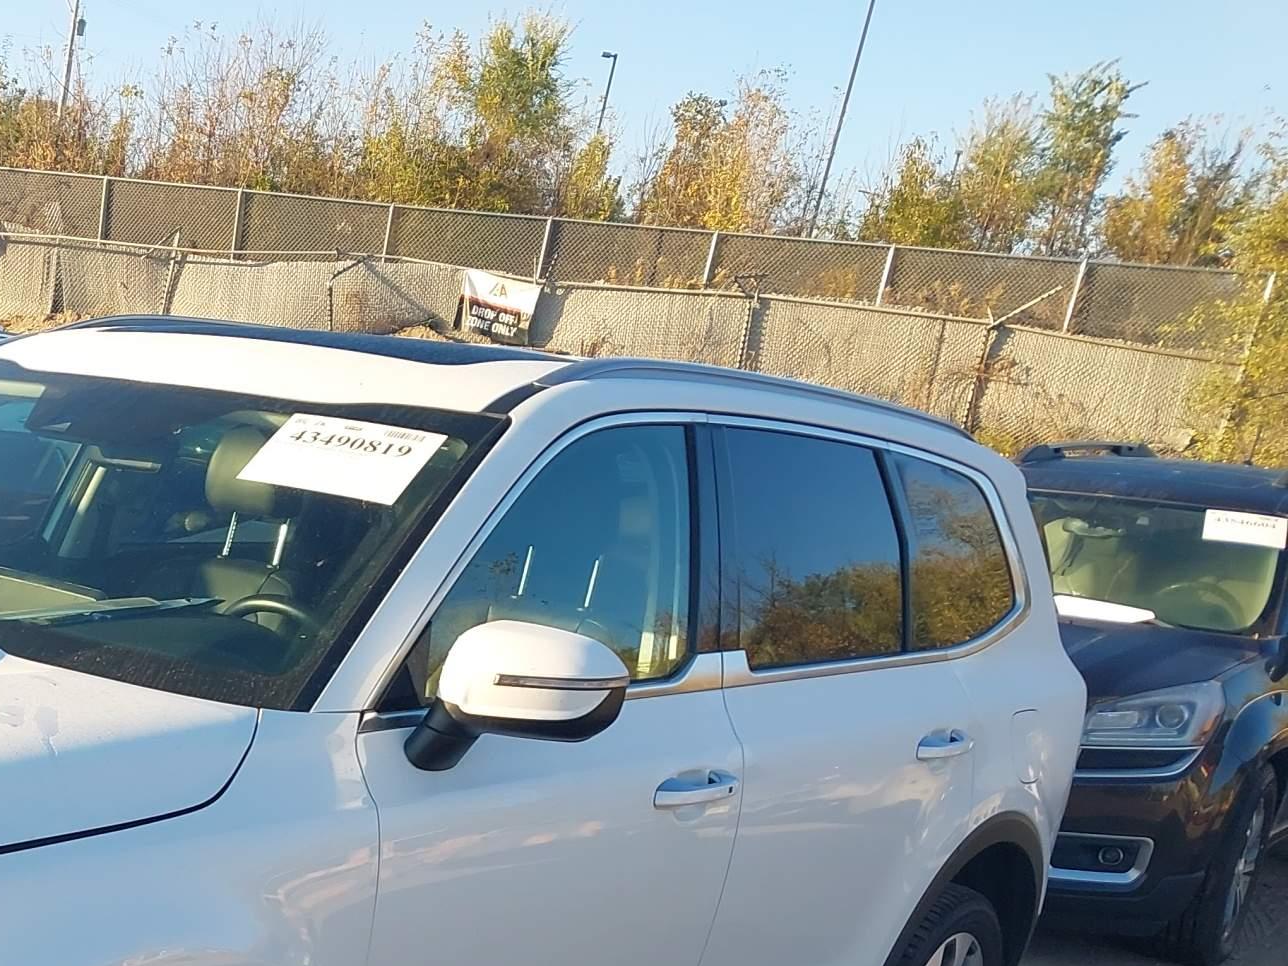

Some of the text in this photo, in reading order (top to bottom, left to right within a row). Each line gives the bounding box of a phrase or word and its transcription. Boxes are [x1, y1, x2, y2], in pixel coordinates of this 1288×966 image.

[472, 305, 497, 320] DROP
[491, 322, 518, 336] ONLY
[289, 430, 413, 457] 43490819
